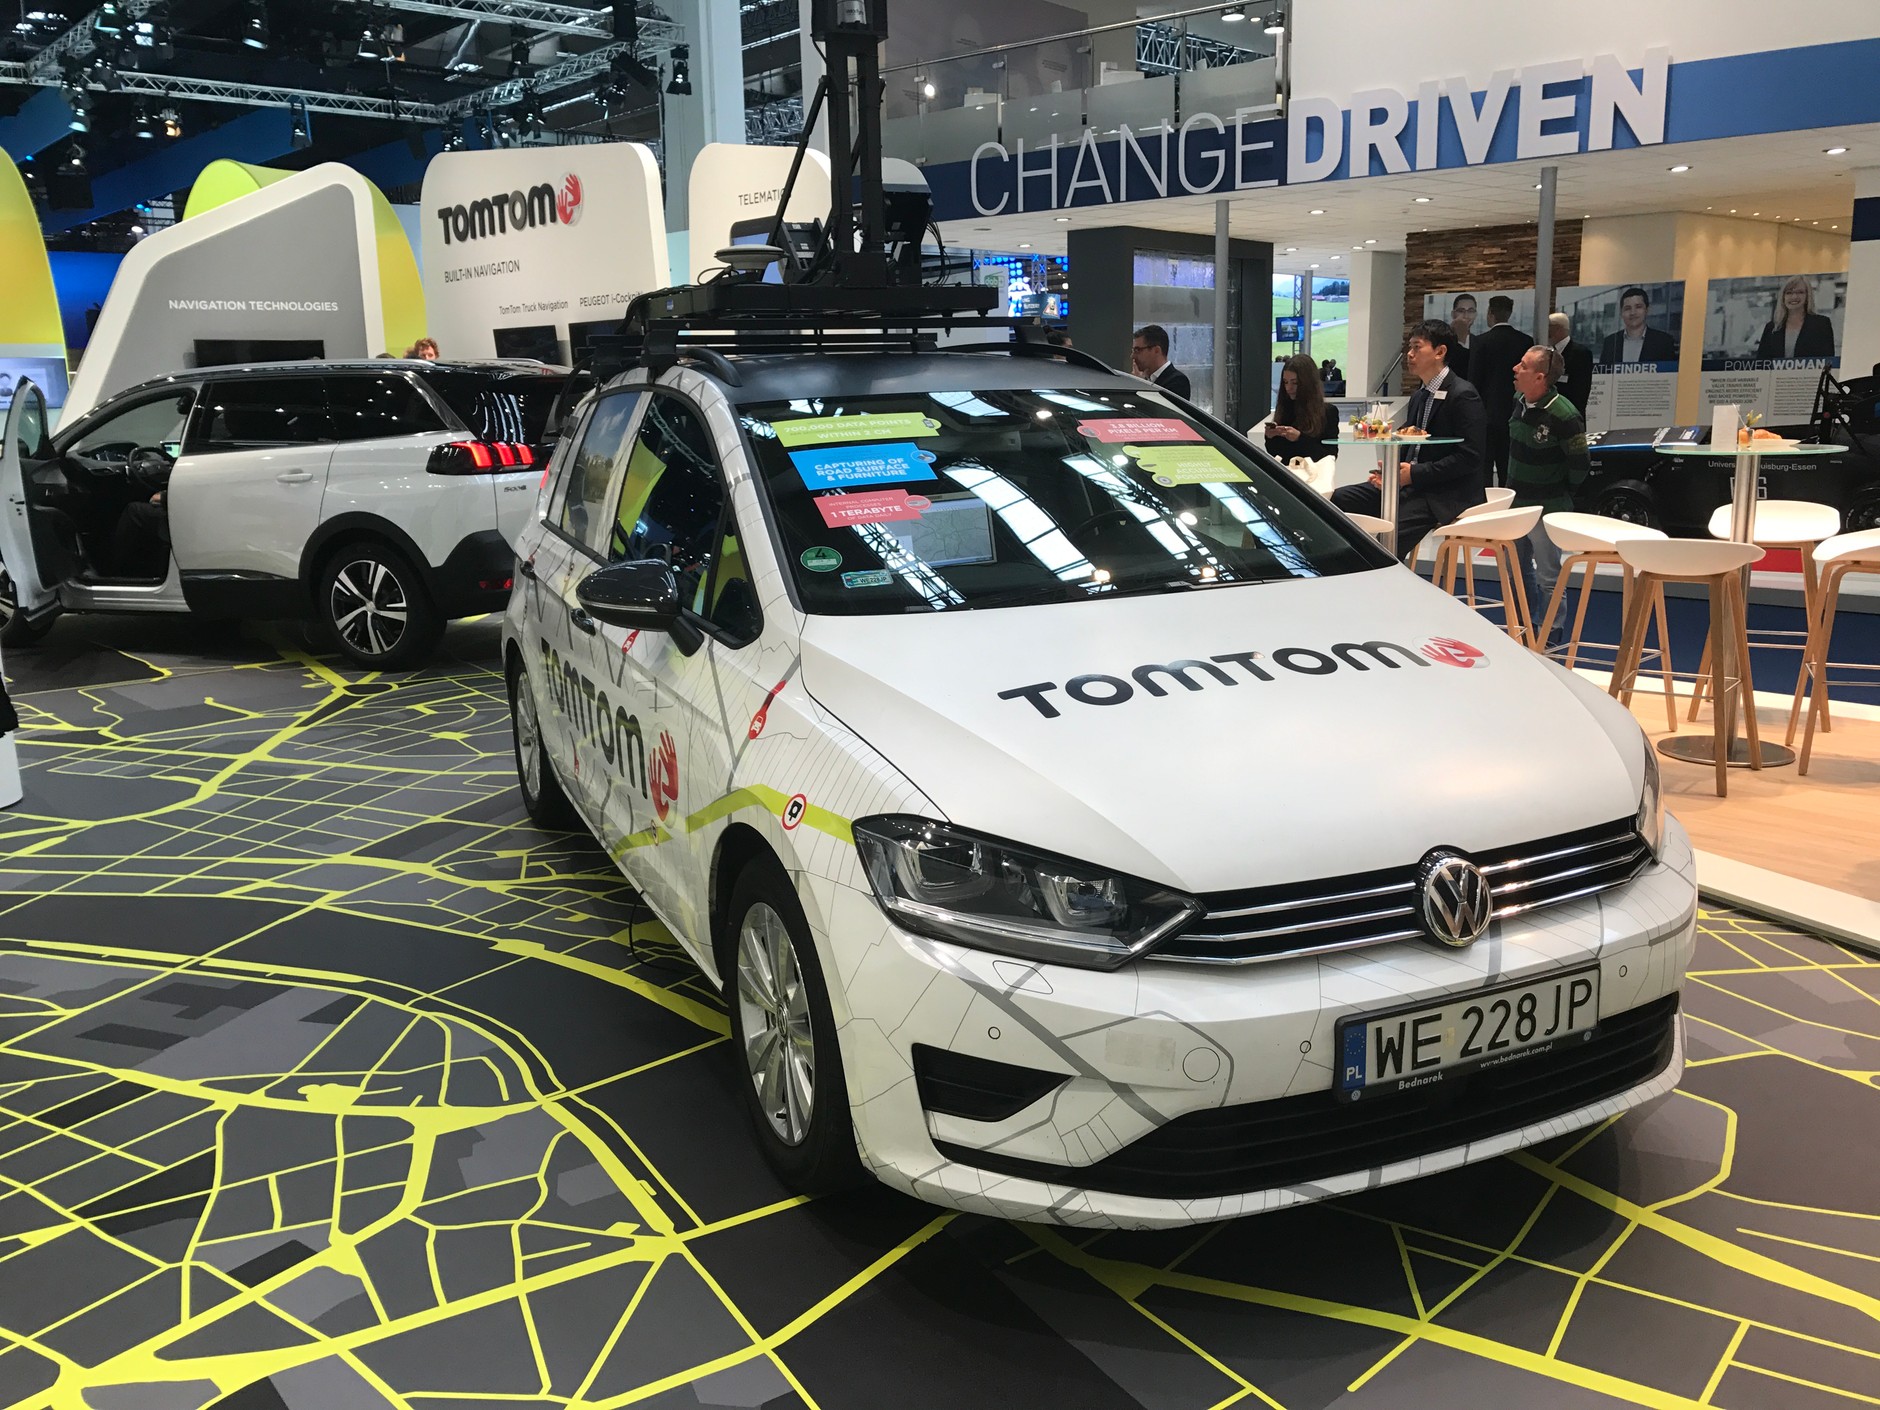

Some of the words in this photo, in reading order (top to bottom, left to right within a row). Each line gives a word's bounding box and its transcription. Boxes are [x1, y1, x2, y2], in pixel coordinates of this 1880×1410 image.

[444, 267, 473, 283] BUILT-IN
[473, 259, 520, 278] NAVIGATION
[168, 299, 246, 311] NAVIGATION
[249, 300, 339, 312] TECHNOLOGIES
[499, 303, 521, 315] TomTom
[522, 302, 537, 313] Truck
[537, 300, 569, 313] Navigation
[579, 296, 610, 307] PEUGEOT
[1591, 363, 1657, 374] ATHFINDER
[784, 423, 834, 433] 700,000
[835, 420, 867, 429] DATA
[869, 418, 912, 427] POINTS
[817, 430, 861, 440] WITHIN
[863, 429, 872, 437] 2
[874, 428, 892, 436] CM
[814, 459, 885, 471] CAPTURING
[887, 457, 905, 465] OF
[816, 467, 852, 477] ROAD
[853, 463, 911, 474] SURFACE
[1175, 466, 1227, 474] ACCURATE
[1178, 461, 1211, 469] HIGHLY
[1760, 462, 1817, 472] uisburg-Essen
[837, 468, 908, 481] FURNITURE
[1174, 472, 1239, 481] POSITIONING
[860, 496, 894, 505] COMPUTER
[830, 511, 838, 519] 1
[838, 505, 903, 518] TERABYTE
[1375, 1012, 1442, 1079] WE
[1346, 1066, 1363, 1082] PL
[1398, 1071, 1444, 1091] Bednarek
